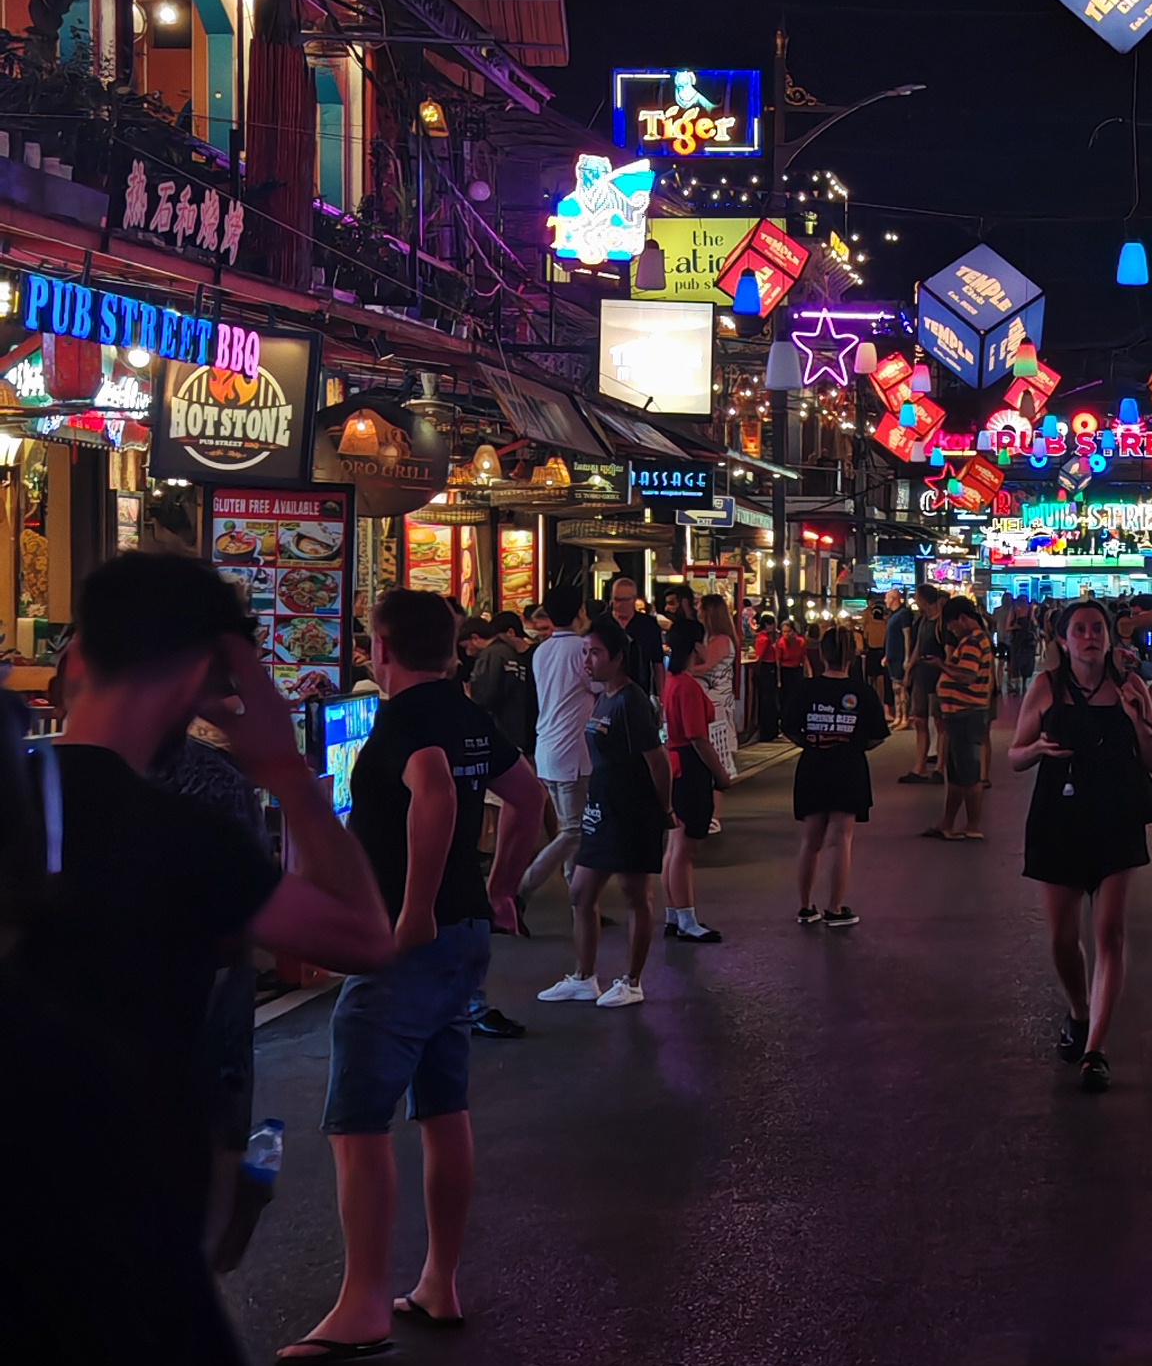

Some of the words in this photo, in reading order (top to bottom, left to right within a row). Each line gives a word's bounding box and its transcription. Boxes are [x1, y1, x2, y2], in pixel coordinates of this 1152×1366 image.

[638, 106, 736, 155] Tiger
[693, 230, 723, 247] the
[675, 278, 699, 294] pub
[955, 265, 1013, 312] TEMPLE
[25, 274, 92, 339] PUB
[100, 292, 213, 366] STREET
[215, 323, 260, 380] BBQ
[923, 316, 974, 365] TEMPLE
[170, 396, 219, 439] HOT
[220, 404, 292, 447] STONE
[199, 438, 214, 446] PUB
[215, 440, 243, 448] STREET
[995, 430, 1067, 456] PUB
[382, 464, 430, 480] GRILL
[213, 496, 246, 514] GLUTEN
[249, 499, 270, 514] FREE
[272, 498, 320, 516] AVAILABLE
